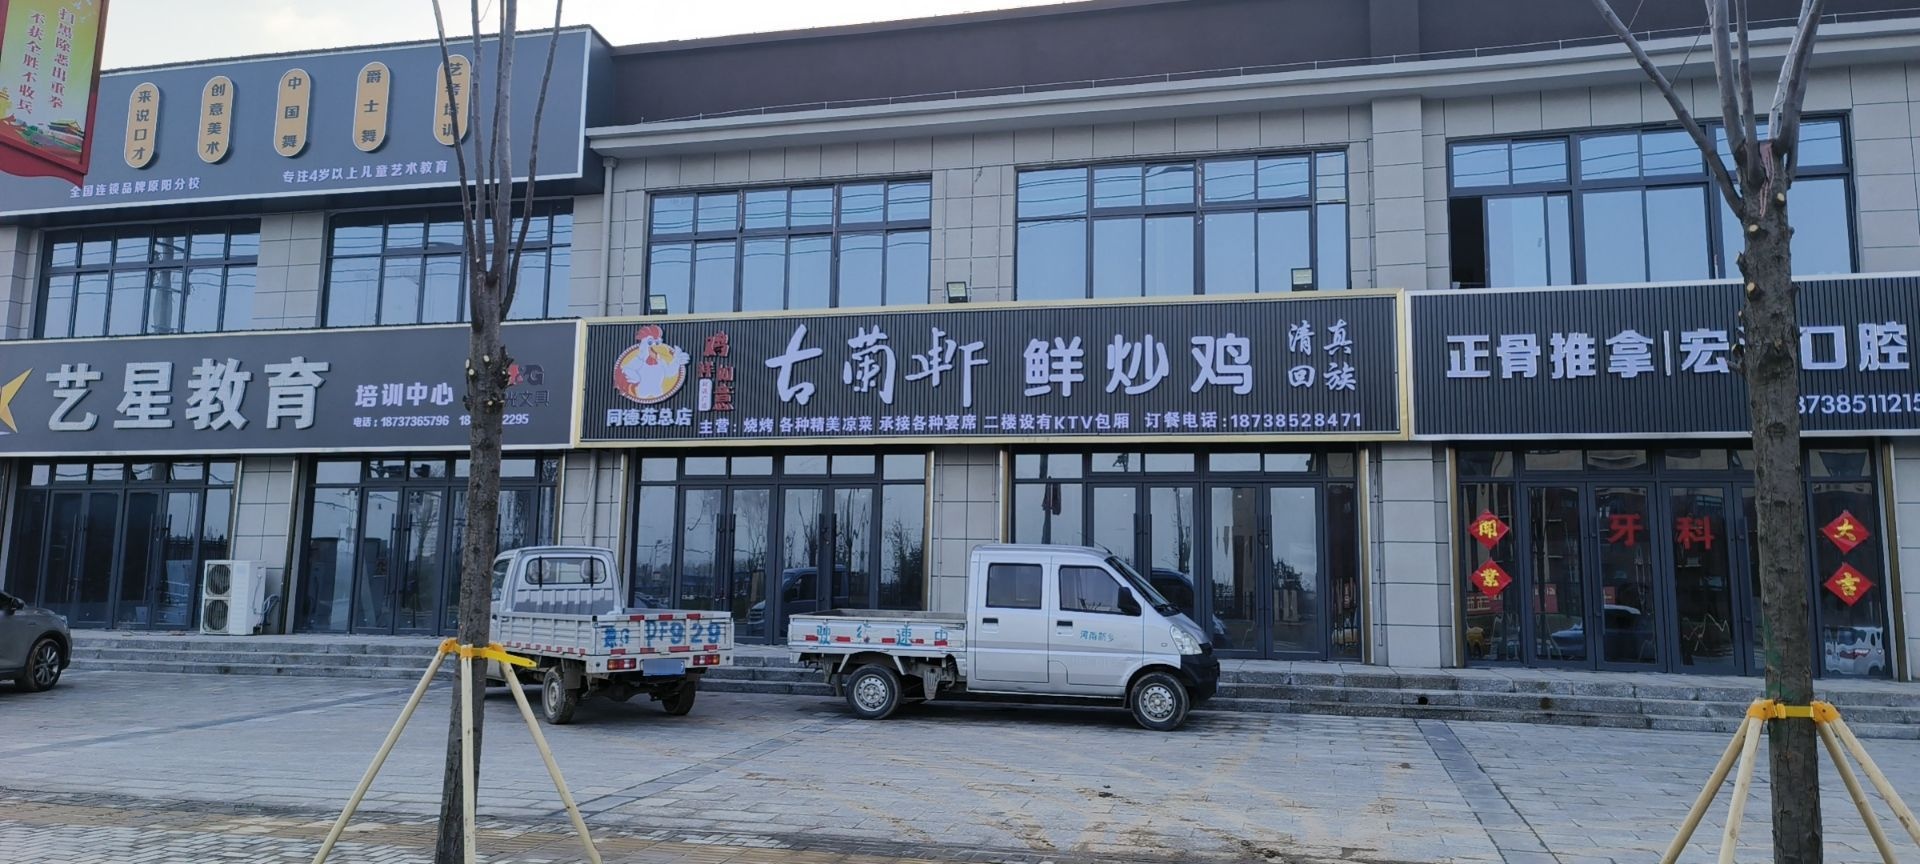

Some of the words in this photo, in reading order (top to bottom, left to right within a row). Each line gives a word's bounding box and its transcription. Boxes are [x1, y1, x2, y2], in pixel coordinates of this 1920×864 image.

[17, 12, 45, 115] 不获全胜不收兵
[49, 8, 74, 109] 扫黑除恶出重拳
[132, 90, 152, 160] 来说口才
[206, 83, 226, 155] 创意美术
[282, 76, 302, 148] 中国舞
[361, 69, 382, 143] 爵士舞
[70, 177, 200, 198] 全国连锁品牌原阳分校
[283, 160, 448, 183] 专注4岁以上儿童艺术教育
[1024, 333, 1253, 397] 鲜炒鸡
[1680, 321, 1910, 374] 宏口腔
[45, 356, 330, 431] 艺星教育
[355, 382, 453, 407] 培训中心
[607, 408, 692, 426] 同德苑总店
[779, 416, 873, 433] 各种精美凉菜
[879, 414, 977, 432] 承接各种宴席
[984, 412, 1129, 430] 二楼设有KTV包厢
